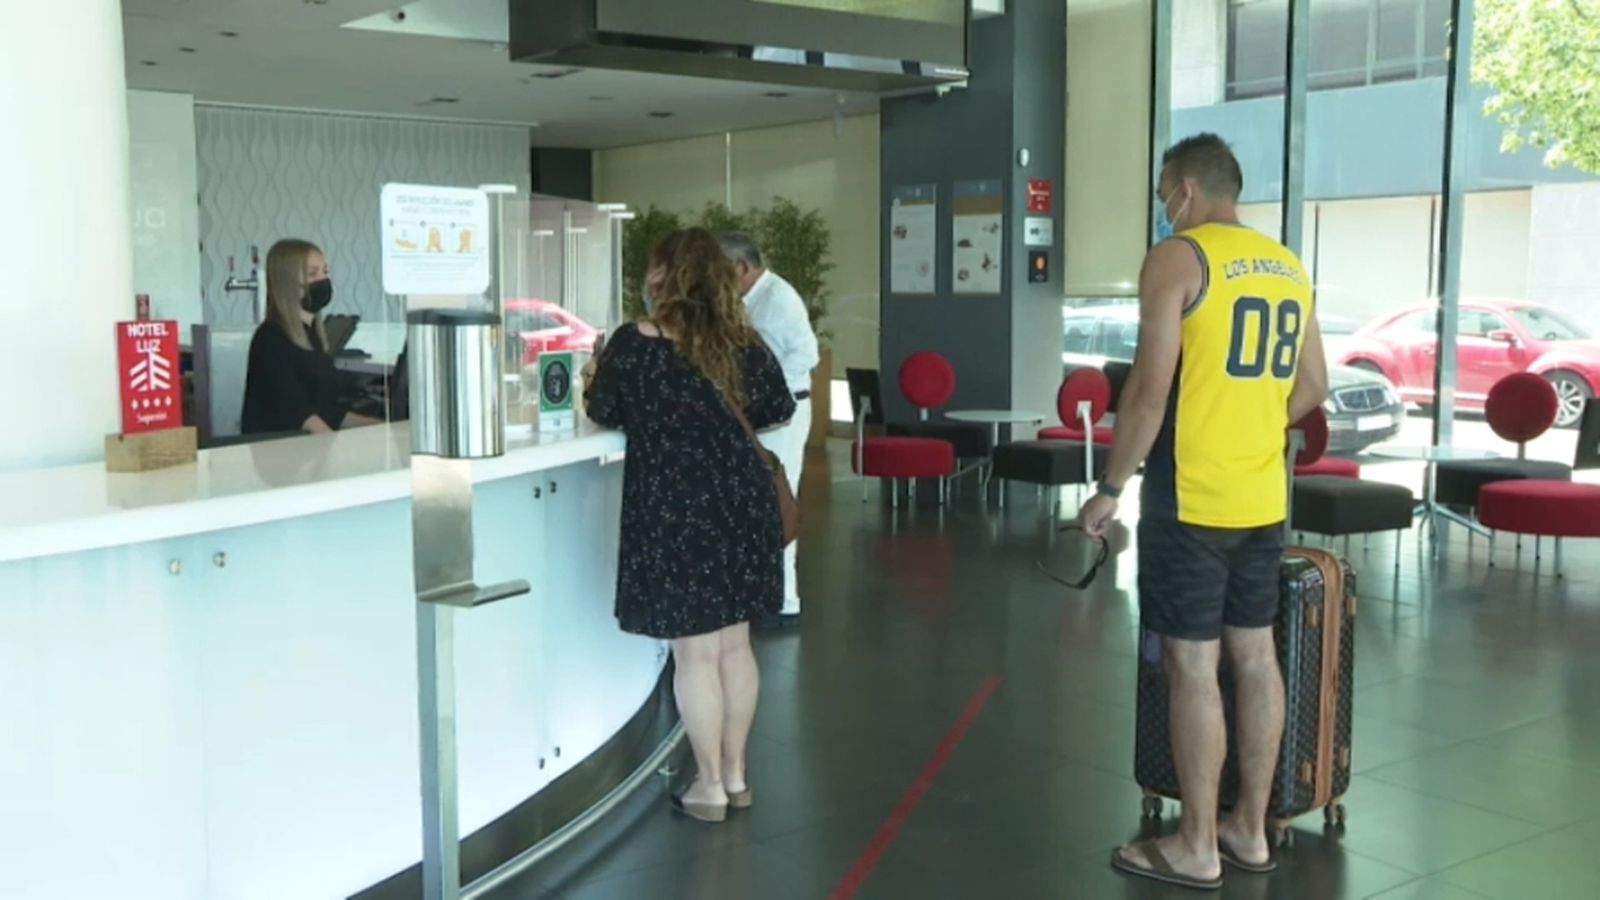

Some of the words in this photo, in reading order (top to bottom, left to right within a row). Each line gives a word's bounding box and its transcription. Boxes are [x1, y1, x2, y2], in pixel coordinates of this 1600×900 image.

[1223, 258, 1250, 280] LOS
[127, 323, 168, 337] HOTEL
[1225, 295, 1301, 379] 08
[136, 339, 161, 354] LUZ
